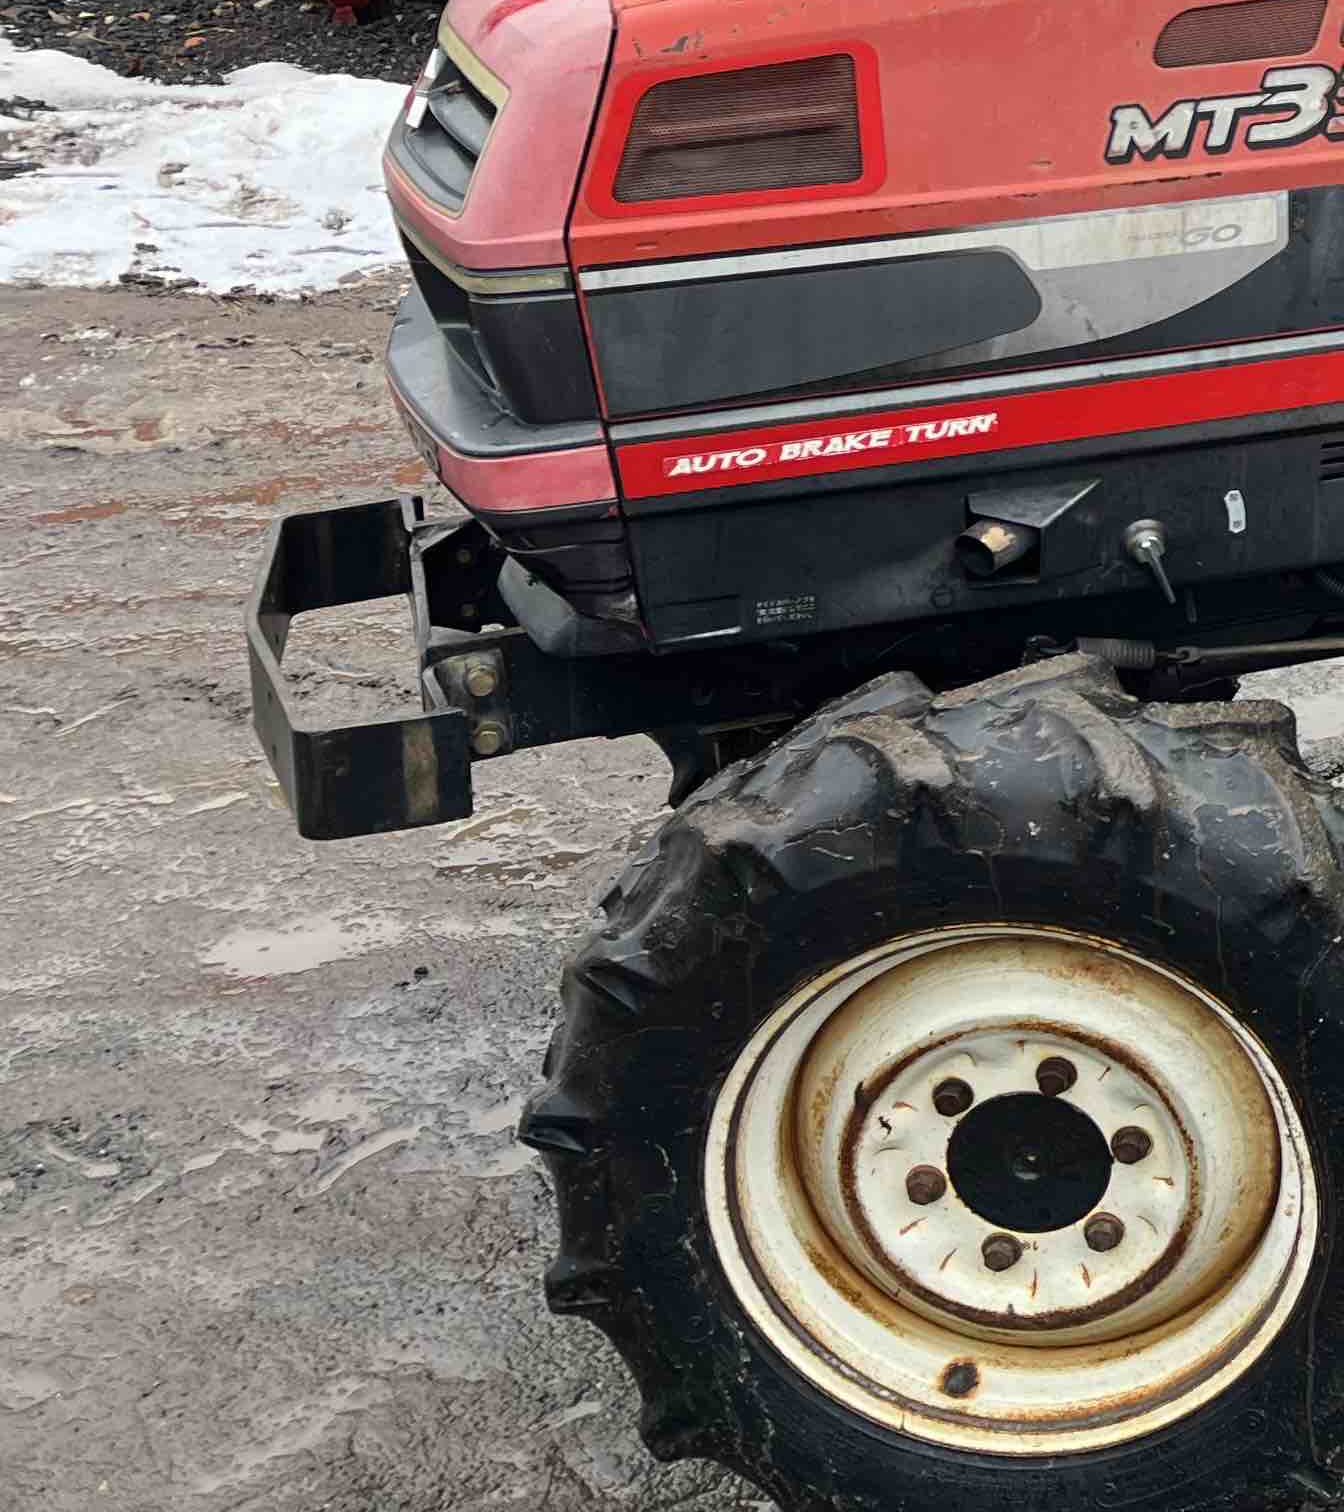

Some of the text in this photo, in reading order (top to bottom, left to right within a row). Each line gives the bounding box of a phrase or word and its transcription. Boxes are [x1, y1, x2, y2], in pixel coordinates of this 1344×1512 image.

[667, 412, 999, 478] AUTO BRAKE TURN
